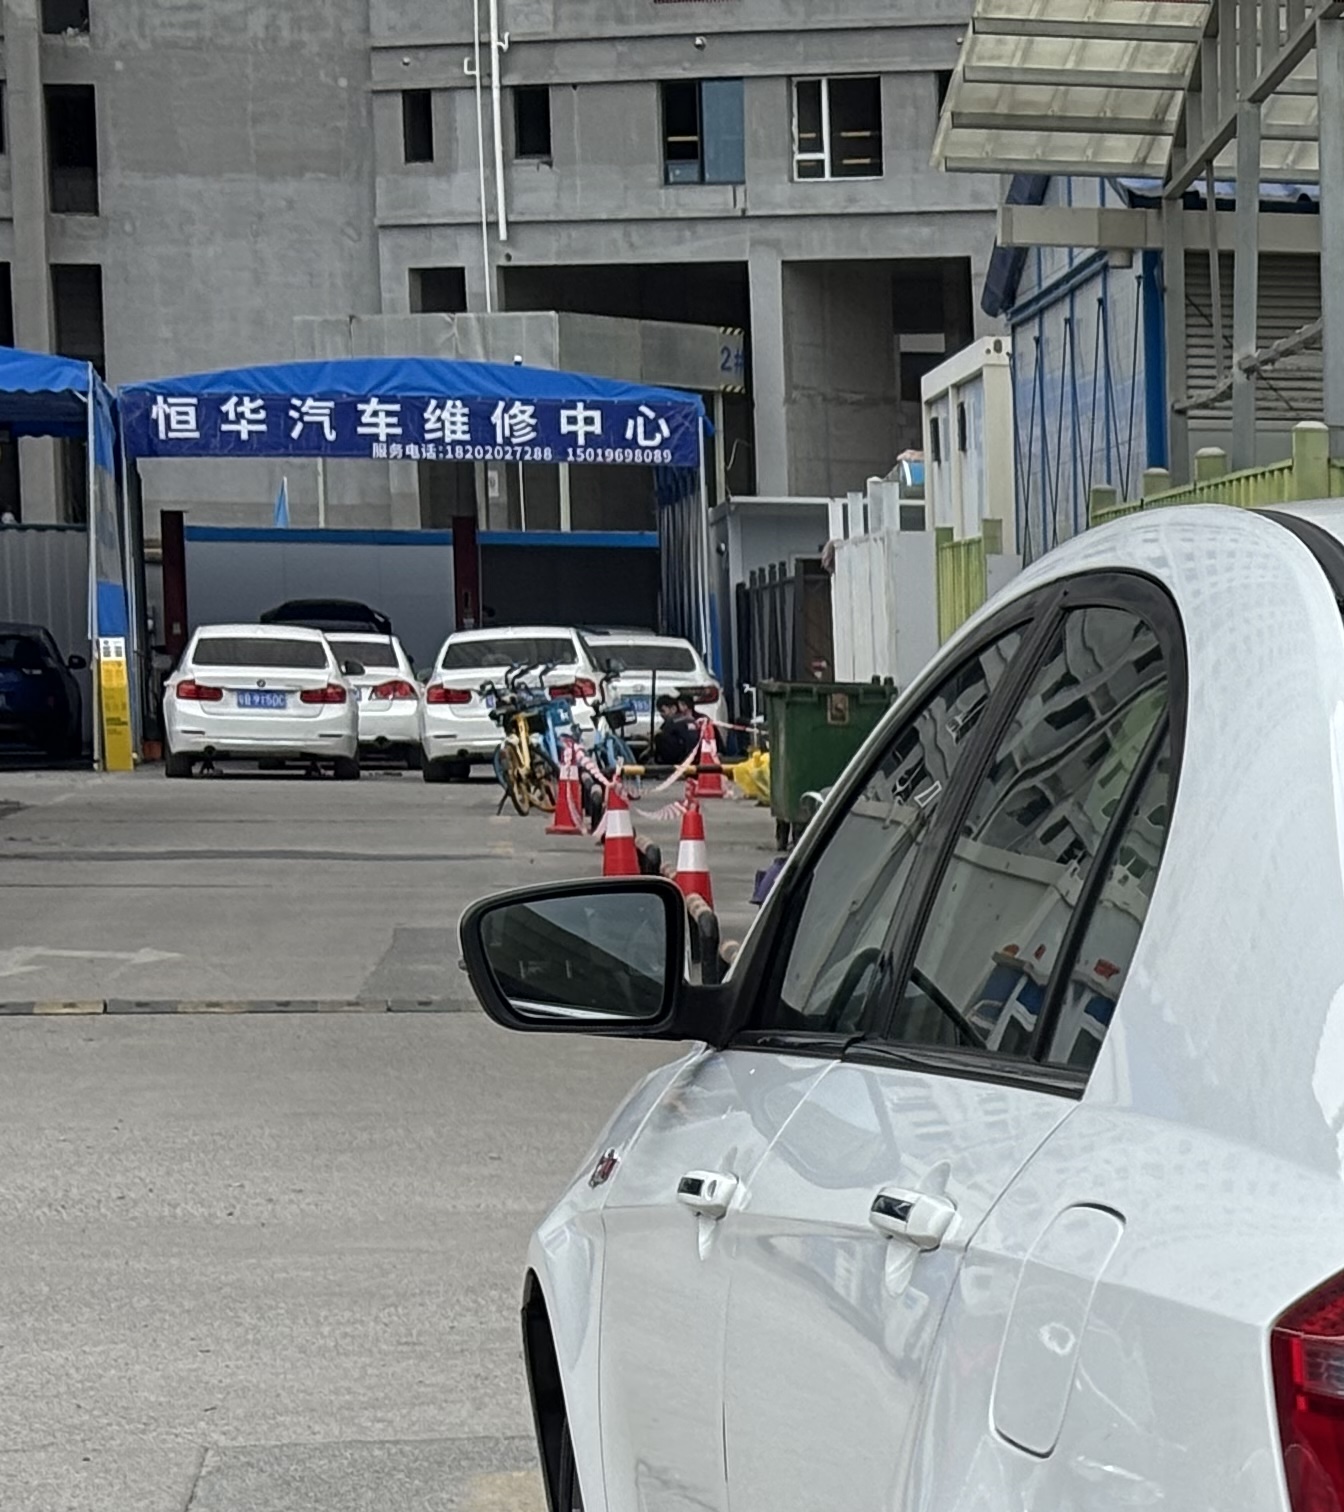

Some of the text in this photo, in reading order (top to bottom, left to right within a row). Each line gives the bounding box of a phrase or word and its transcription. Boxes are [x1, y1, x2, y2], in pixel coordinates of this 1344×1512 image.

[151, 394, 671, 447] 恒华汽车维修中心
[567, 447, 672, 463] 15019698089
